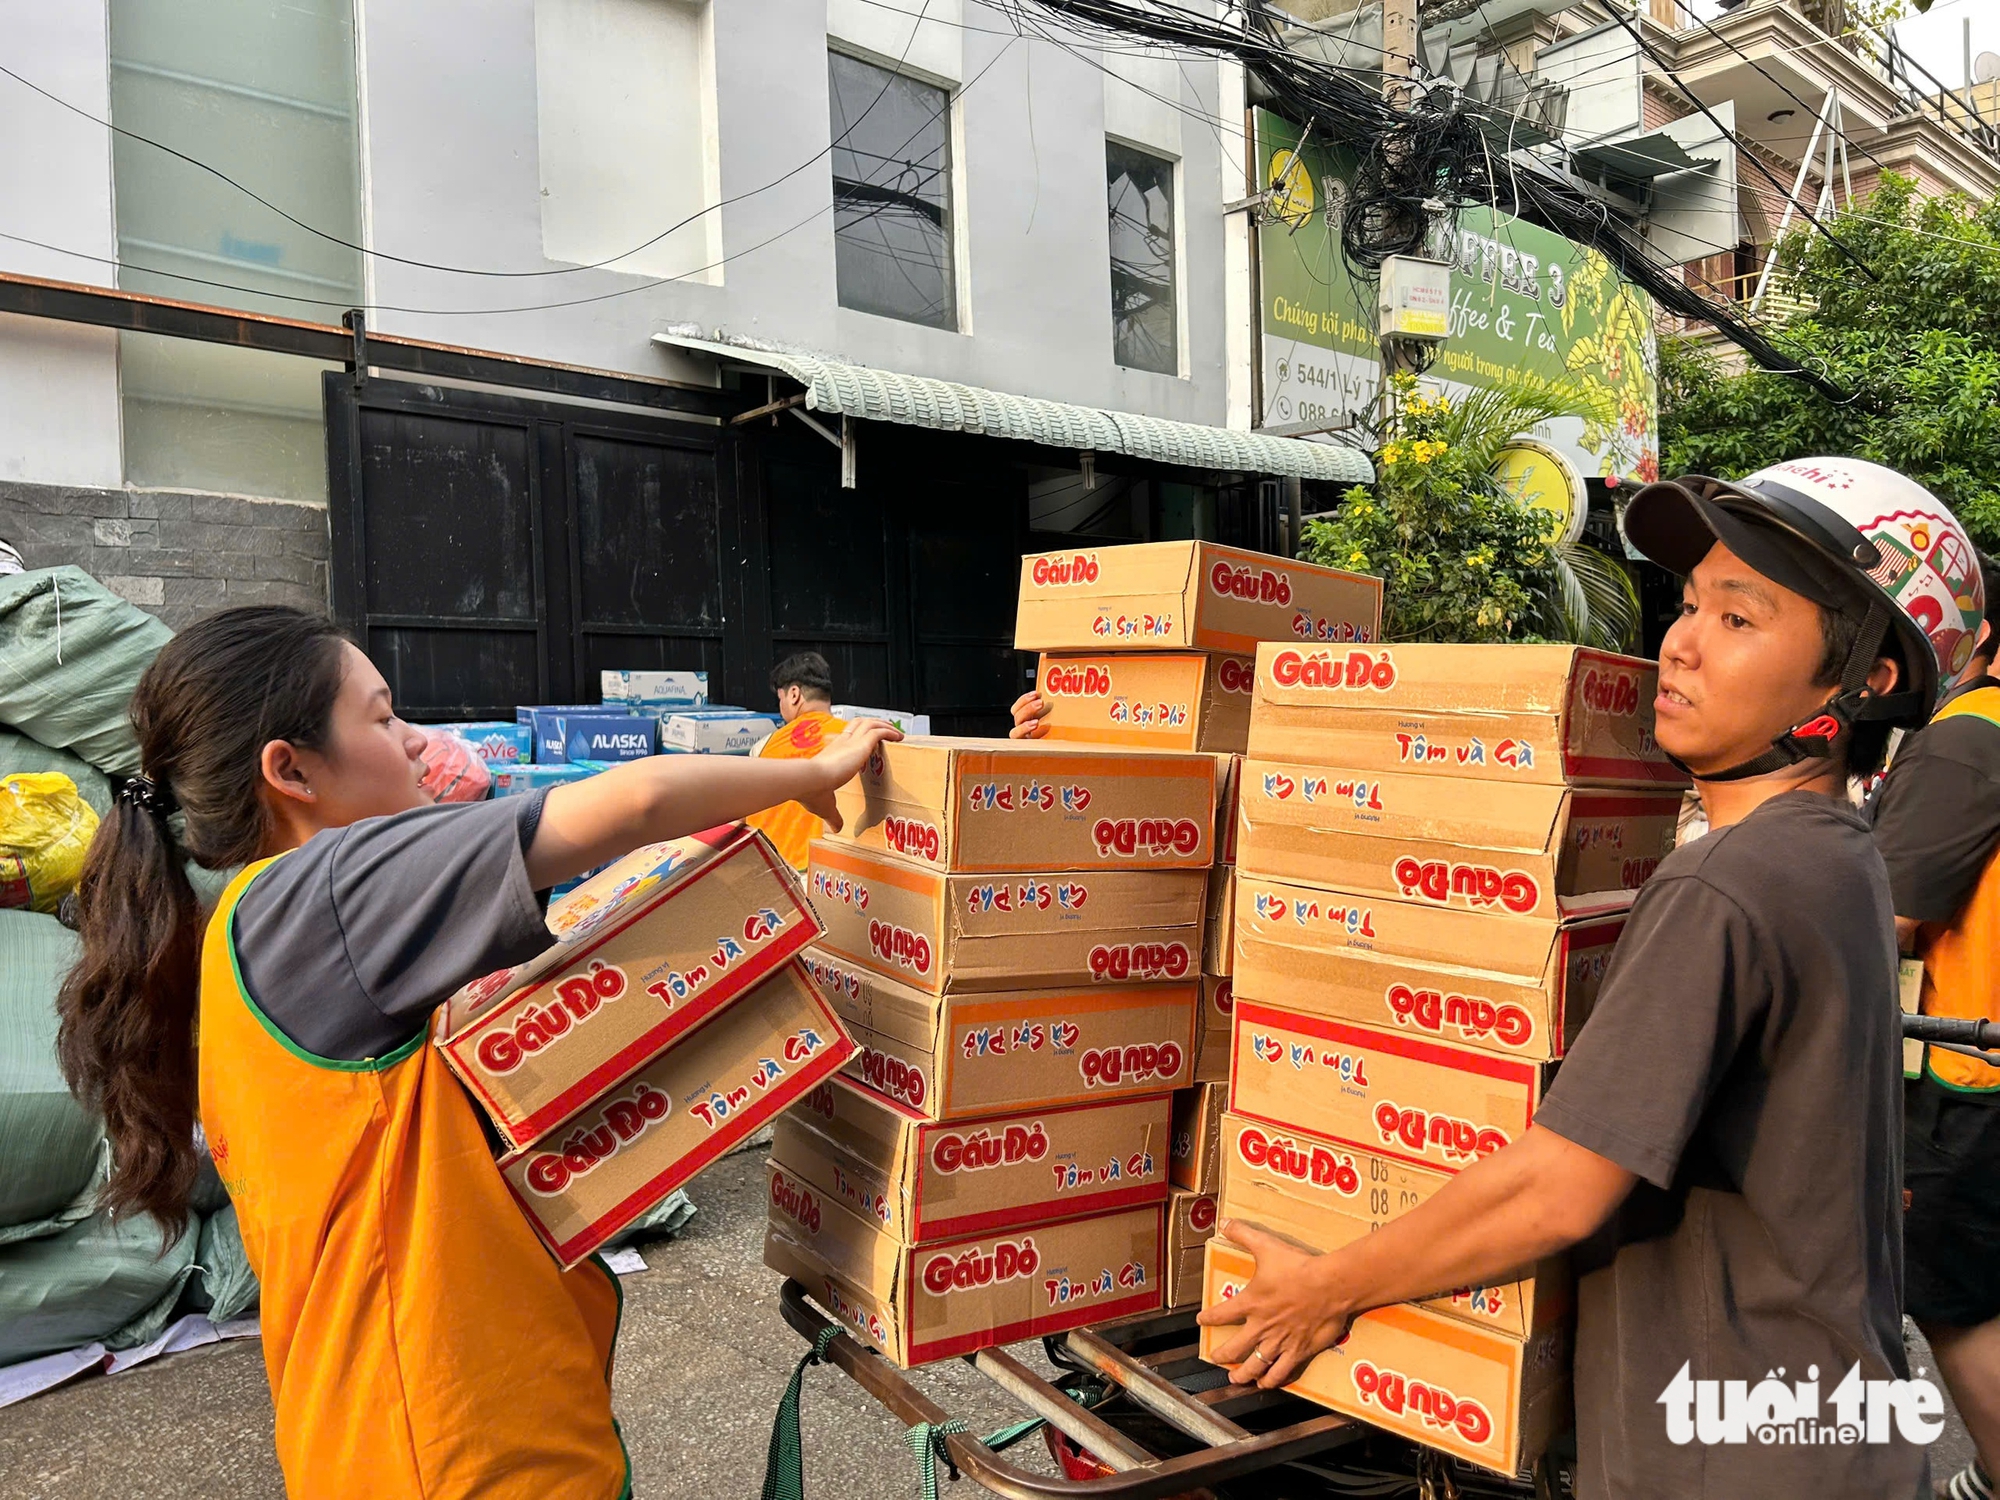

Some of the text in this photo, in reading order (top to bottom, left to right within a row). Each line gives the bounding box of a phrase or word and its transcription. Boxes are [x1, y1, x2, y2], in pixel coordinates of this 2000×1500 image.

[1548, 263, 1566, 309] 3
[1273, 296, 1318, 335] Chúng
[1321, 311, 1340, 336] tôi
[1449, 288, 1489, 338] ffee
[1496, 305, 1515, 341] &
[1525, 312, 1556, 353] Tea
[1298, 363, 1337, 391] 544/1
[1343, 373, 1361, 401] Lý
[1476, 356, 1504, 383] trong
[1093, 615, 1111, 636] Gà
[1292, 613, 1312, 636] Gà
[1110, 701, 1127, 721] Gà
[592, 734, 648, 749] ALASKA
[619, 748, 635, 756] Since
[1396, 733, 1533, 768] Tôm và Gà
[1062, 784, 1092, 811] Gà
[1264, 774, 1382, 810] Tôm và Gà
[1058, 882, 1087, 908] Gà
[1256, 894, 1376, 937] Tôm và Gà
[647, 909, 784, 1008] Tôm và Gà
[1052, 1021, 1080, 1048] Gà
[1253, 1034, 1368, 1086] Tôm và Gà
[690, 1029, 823, 1127] Tôm và Gà
[1053, 1152, 1153, 1190] Tôm và Gà
[874, 1195, 891, 1224] Gà
[1371, 1188, 1389, 1215] 08
[1045, 1263, 1145, 1306] Tôm và Gà
[825, 1281, 887, 1344] Tôm và Gà
